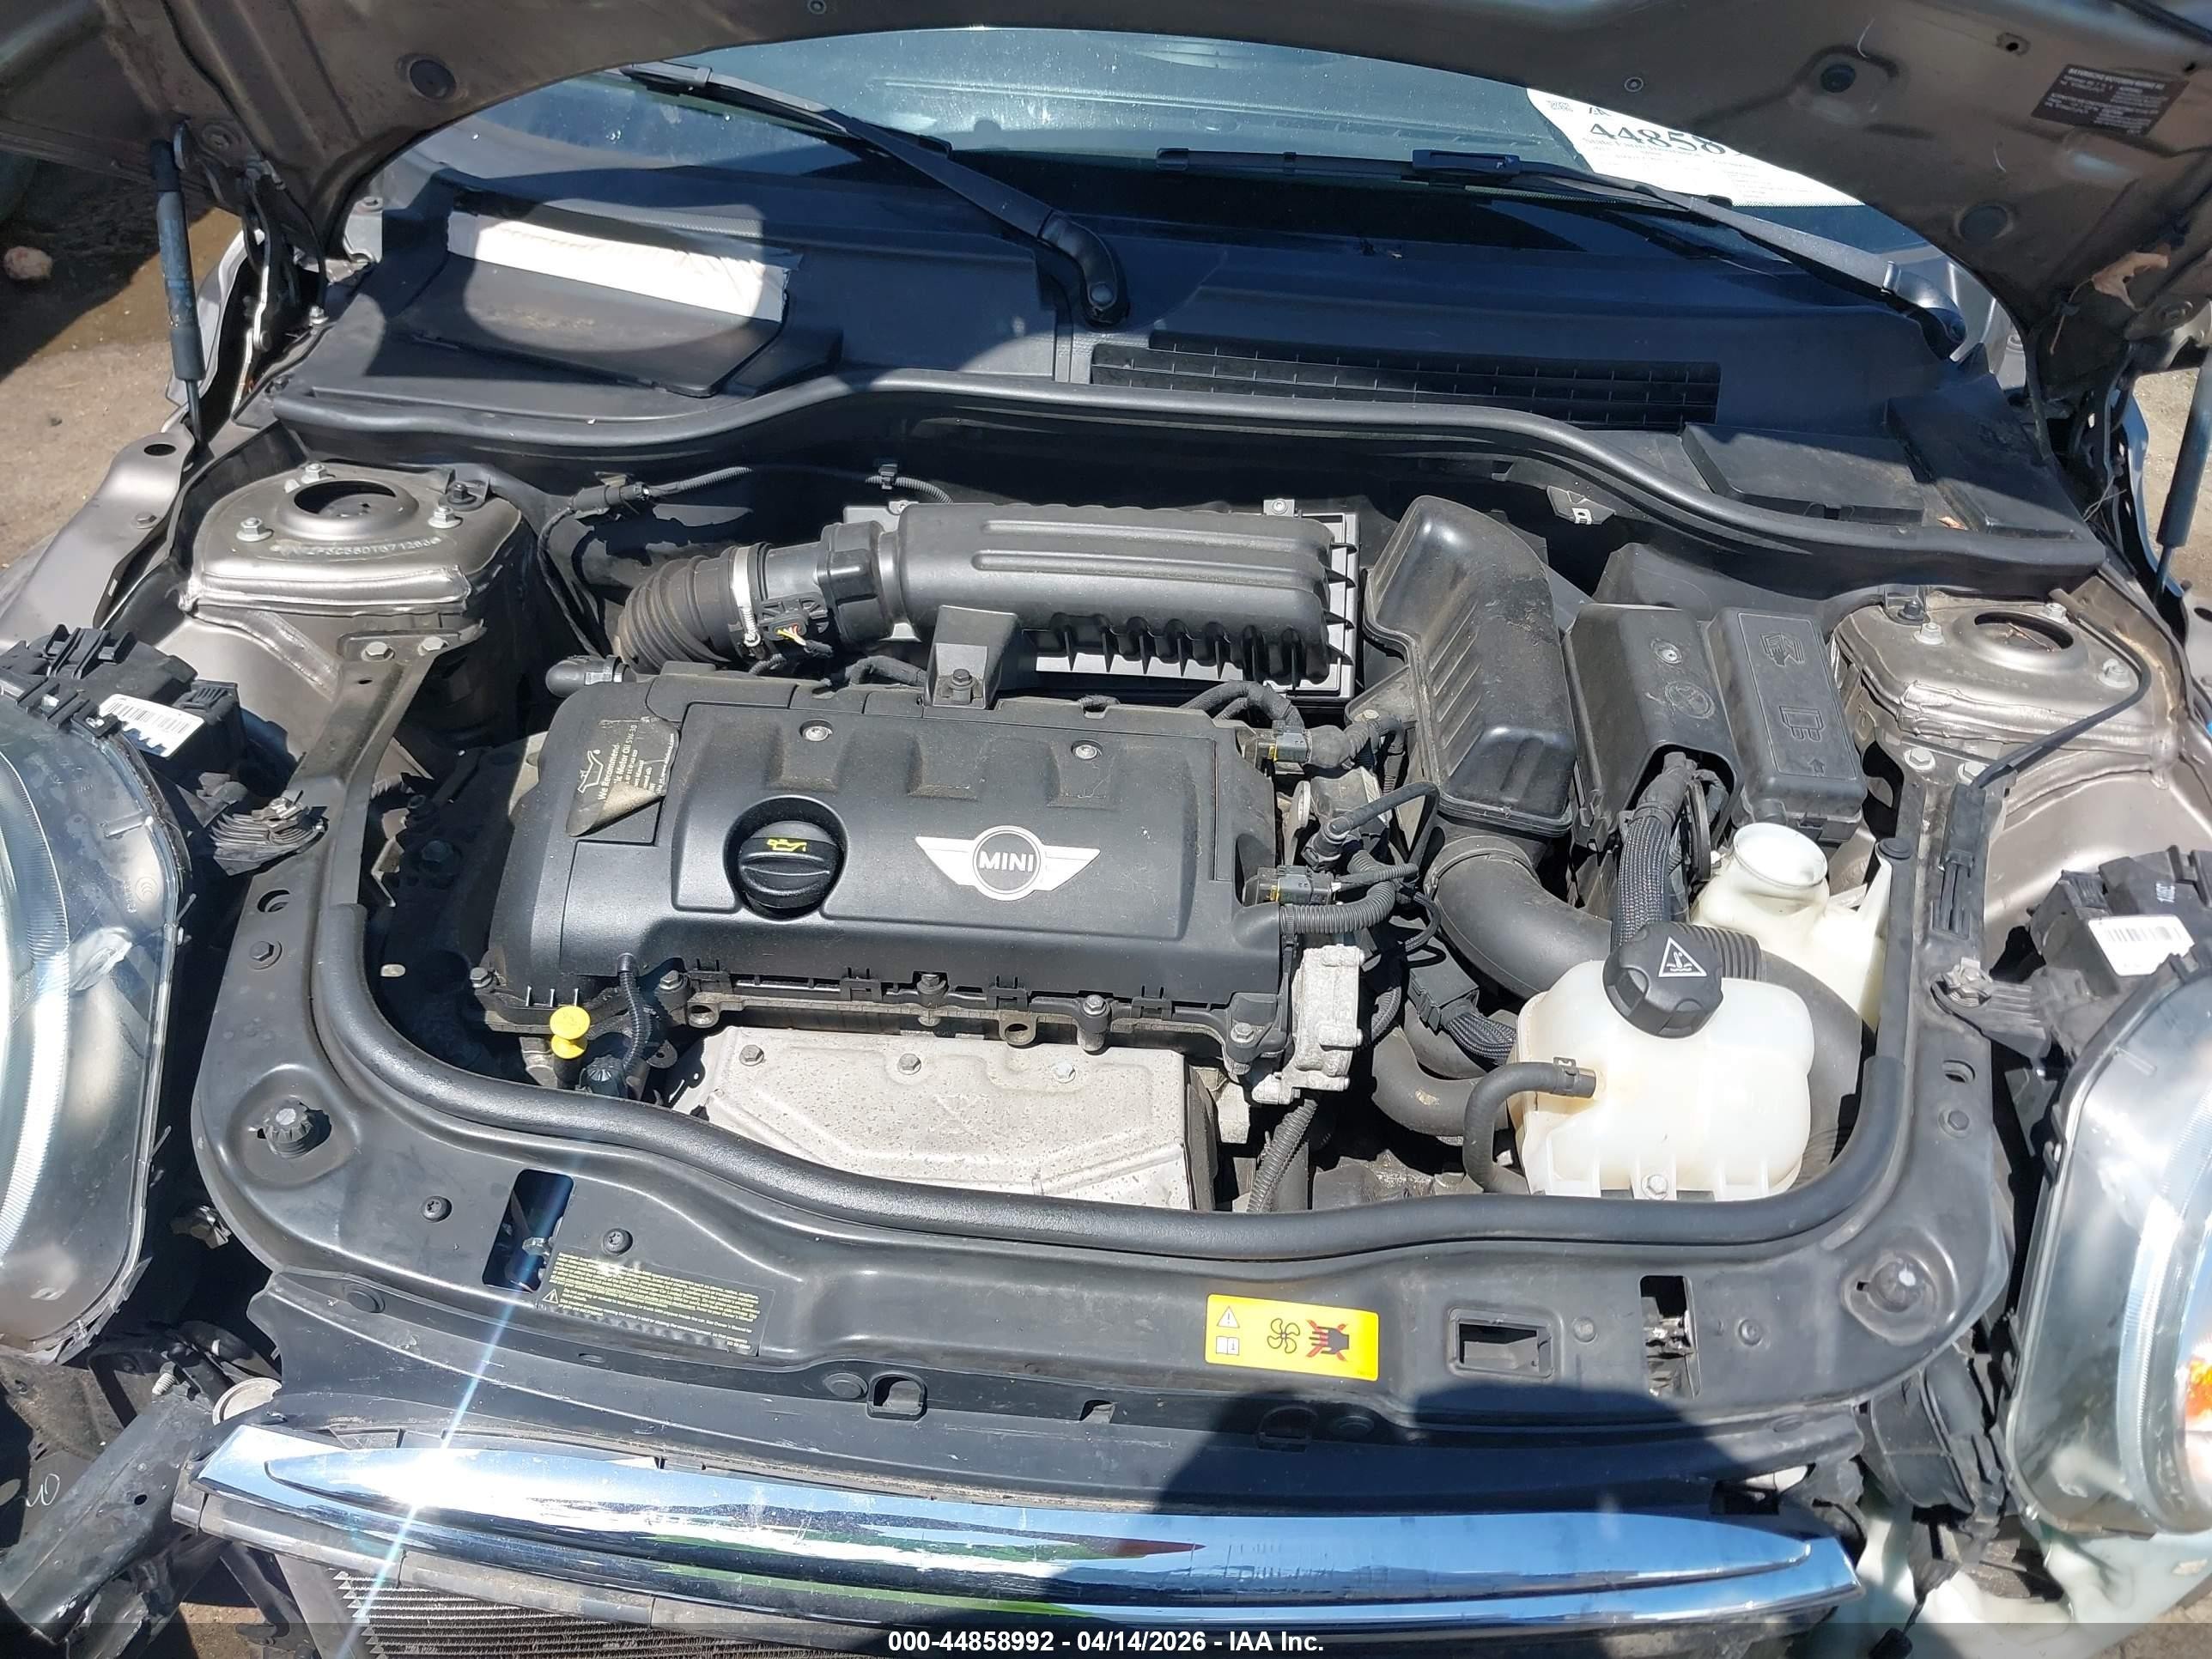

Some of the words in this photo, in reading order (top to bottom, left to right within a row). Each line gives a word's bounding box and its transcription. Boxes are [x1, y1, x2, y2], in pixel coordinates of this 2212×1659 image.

[1589, 122, 1742, 155] 44858
[622, 744, 631, 754] Oil
[617, 754, 629, 775] Motor
[598, 787, 608, 800] We
[979, 850, 1034, 872] MINI
